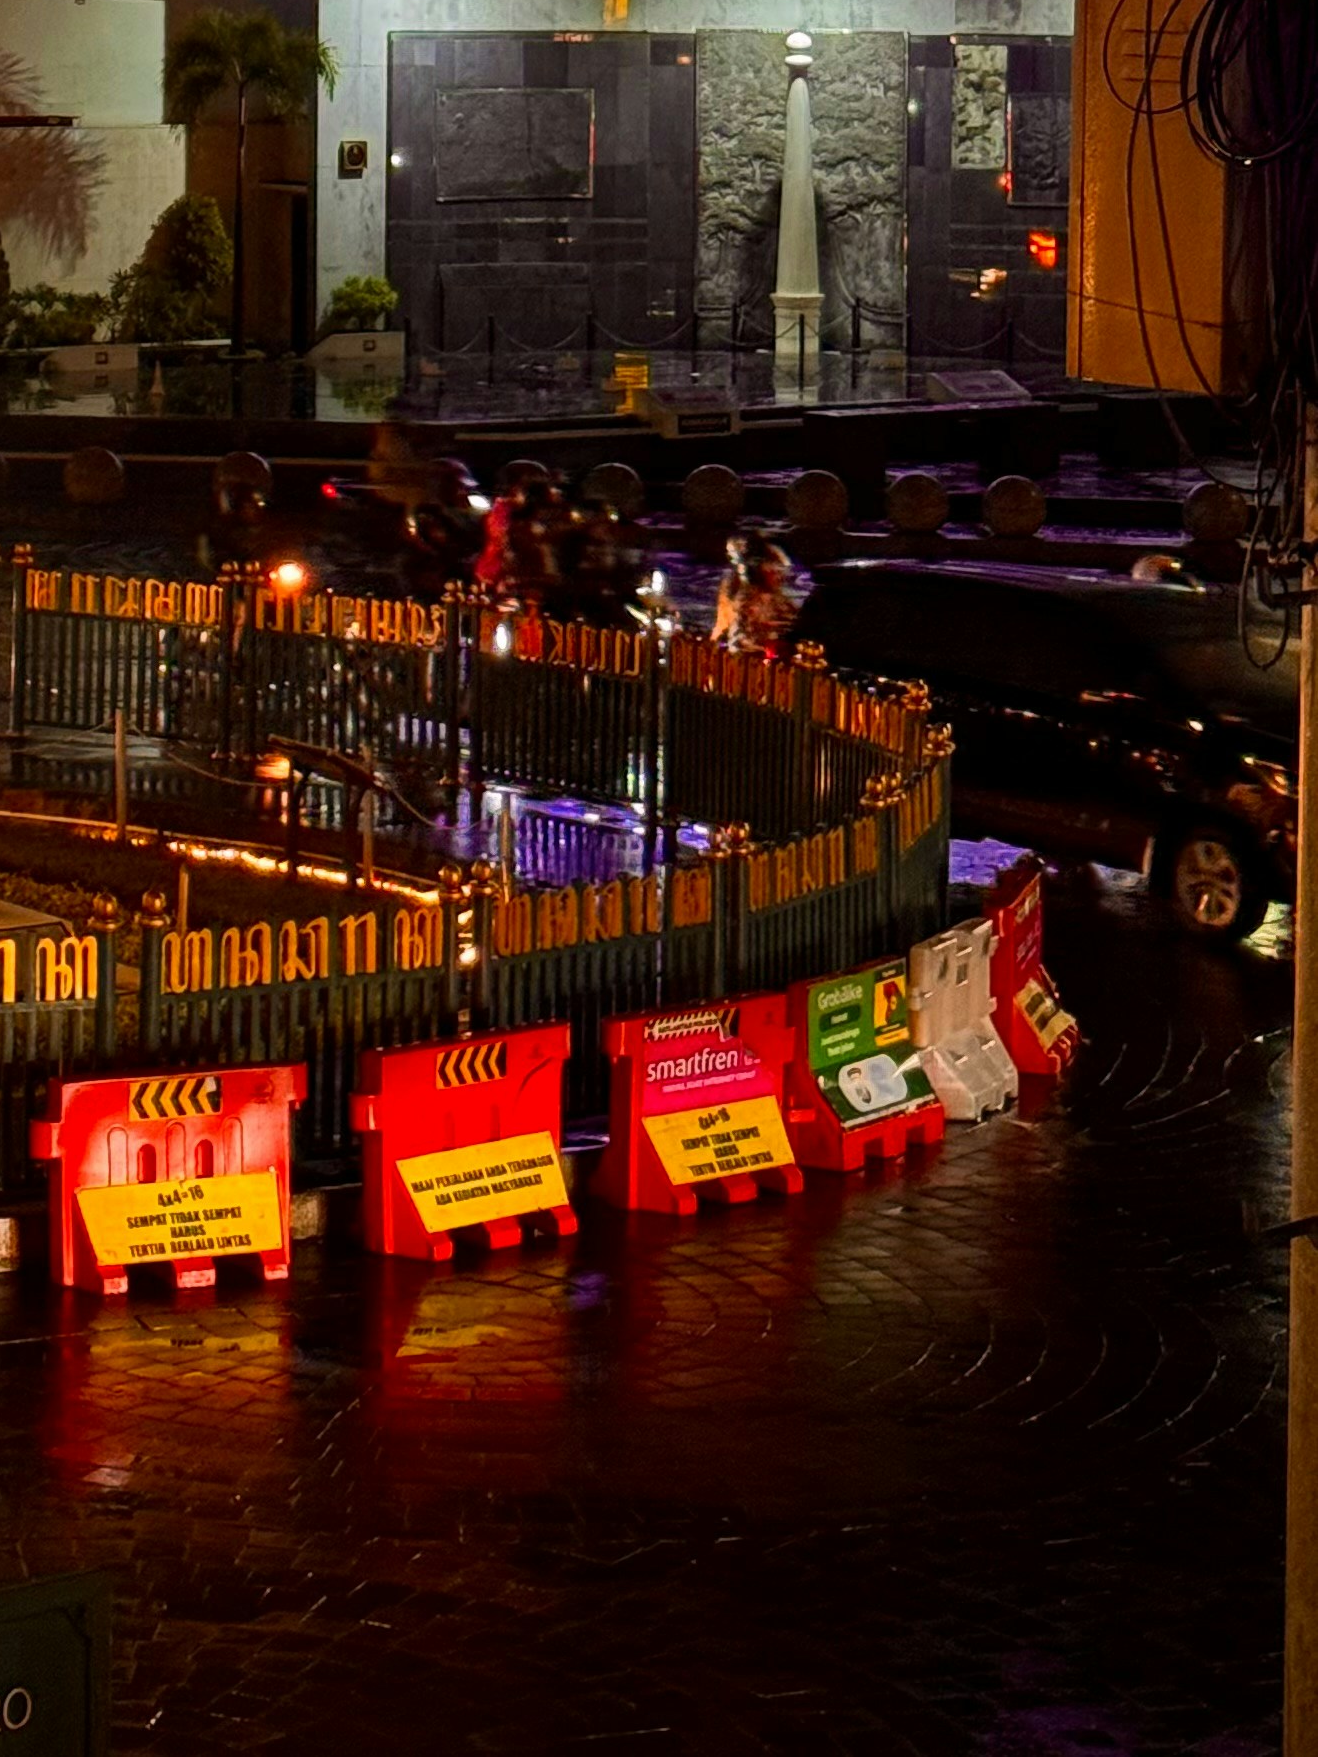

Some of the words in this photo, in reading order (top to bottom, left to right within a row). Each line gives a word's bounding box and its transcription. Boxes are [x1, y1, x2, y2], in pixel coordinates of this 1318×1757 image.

[646, 1048, 739, 1082] smartfren
[157, 1185, 204, 1207] 4x4=16
[126, 1213, 168, 1229] SEMPAT
[169, 1210, 201, 1223] TIDAK
[202, 1206, 242, 1221] SEMPAT
[216, 1234, 252, 1249] LINTAS
